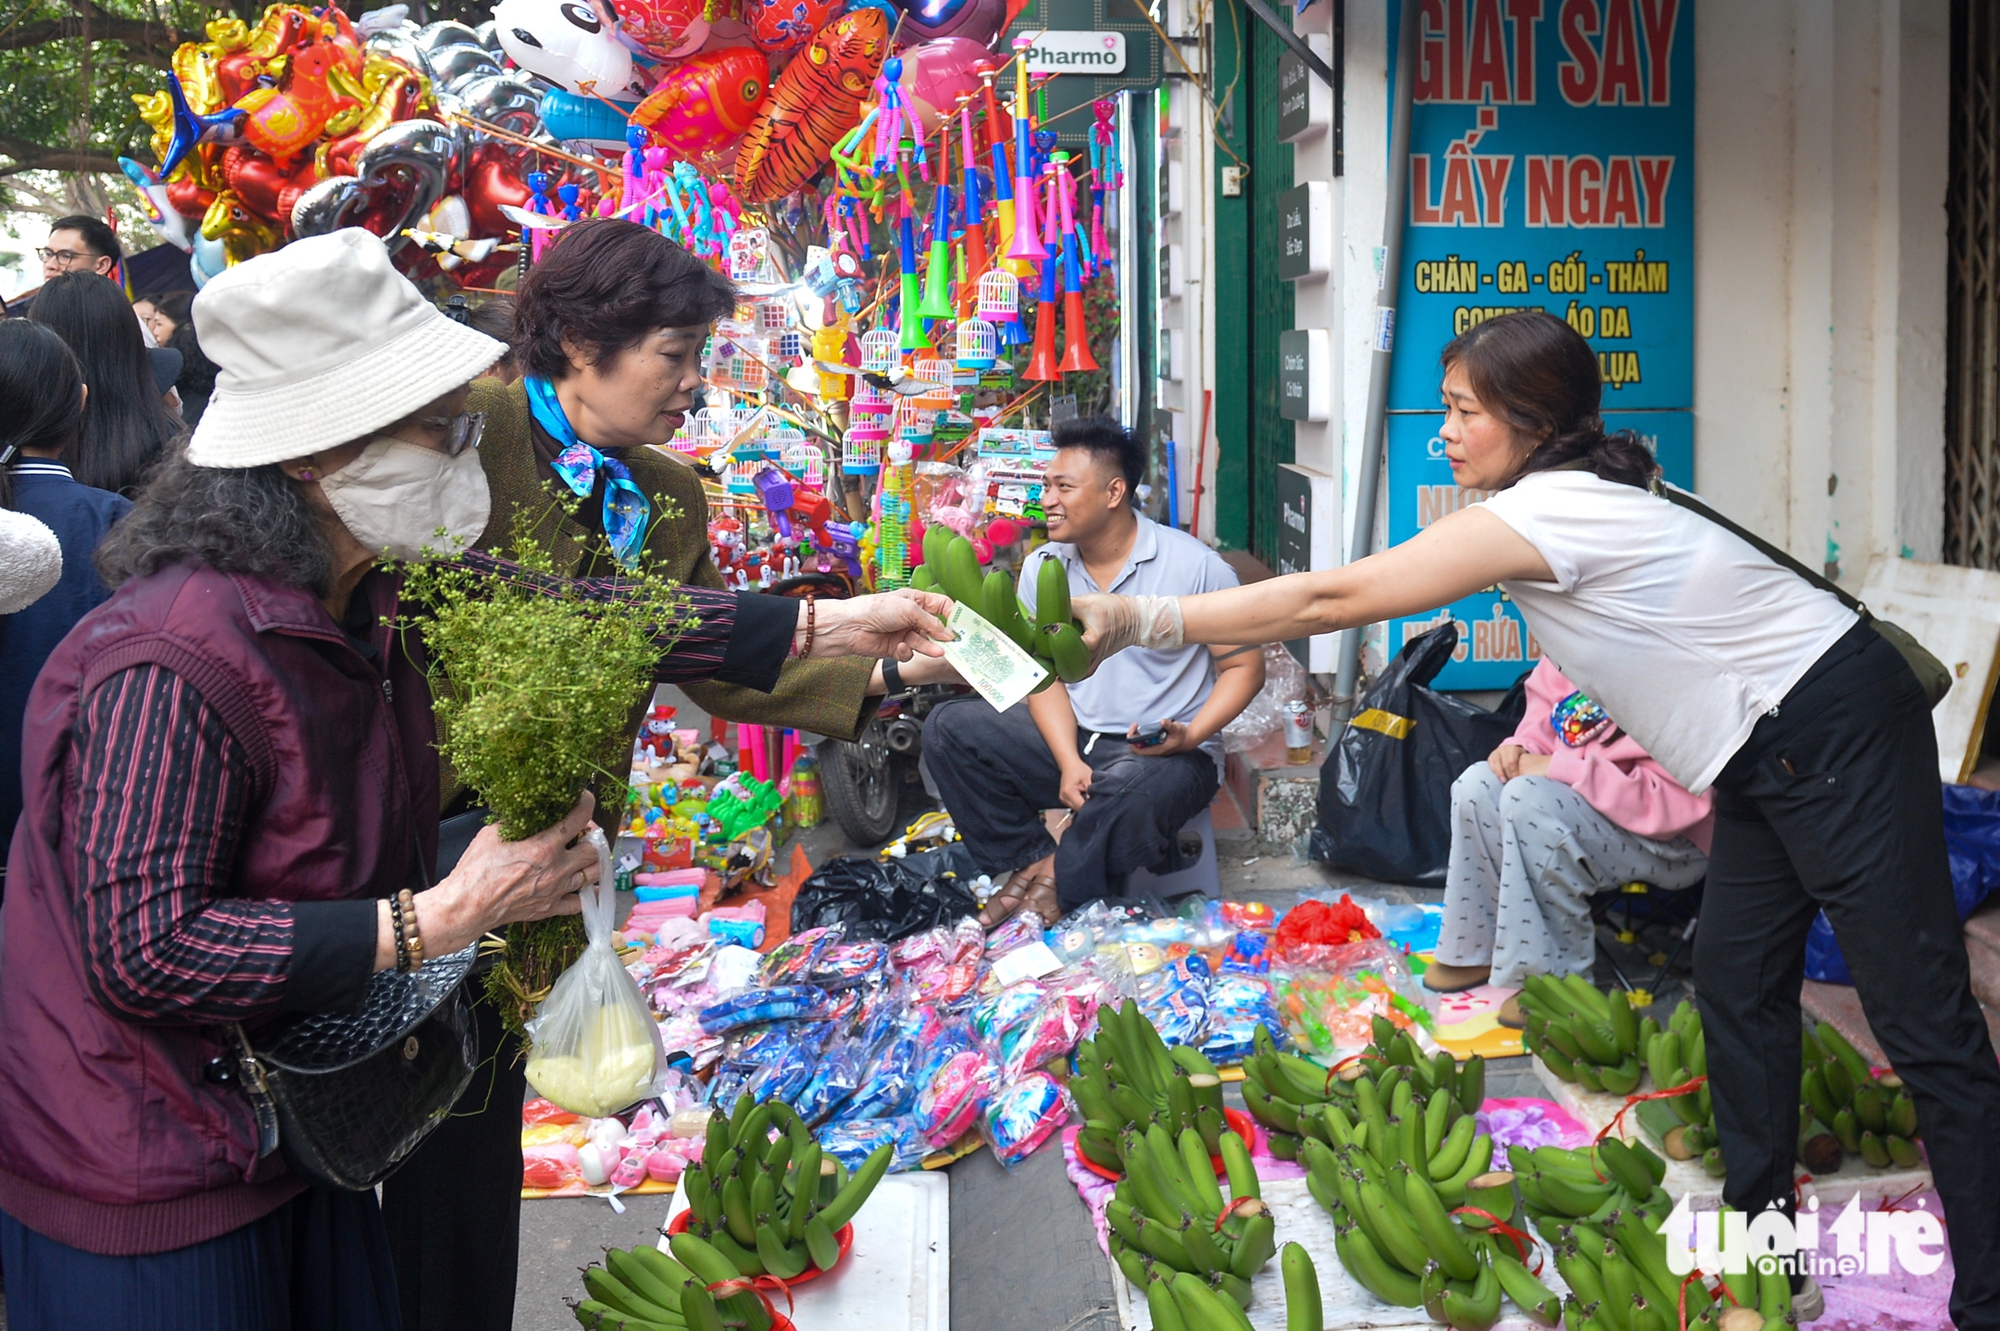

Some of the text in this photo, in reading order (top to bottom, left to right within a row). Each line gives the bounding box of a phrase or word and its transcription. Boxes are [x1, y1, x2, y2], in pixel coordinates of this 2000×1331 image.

[1026, 46, 1117, 65] Pharmo
[1410, 130, 1675, 228] LẤY NGAY
[1415, 254, 1477, 294] CHĂN
[1497, 260, 1529, 294] GA
[1548, 250, 1587, 293] GỐI
[1606, 248, 1669, 294] THẢM
[1566, 300, 1595, 339] ÁO
[1599, 307, 1632, 339] DA
[1284, 502, 1306, 534] Pharmo
[1473, 602, 1522, 662] RỬA
